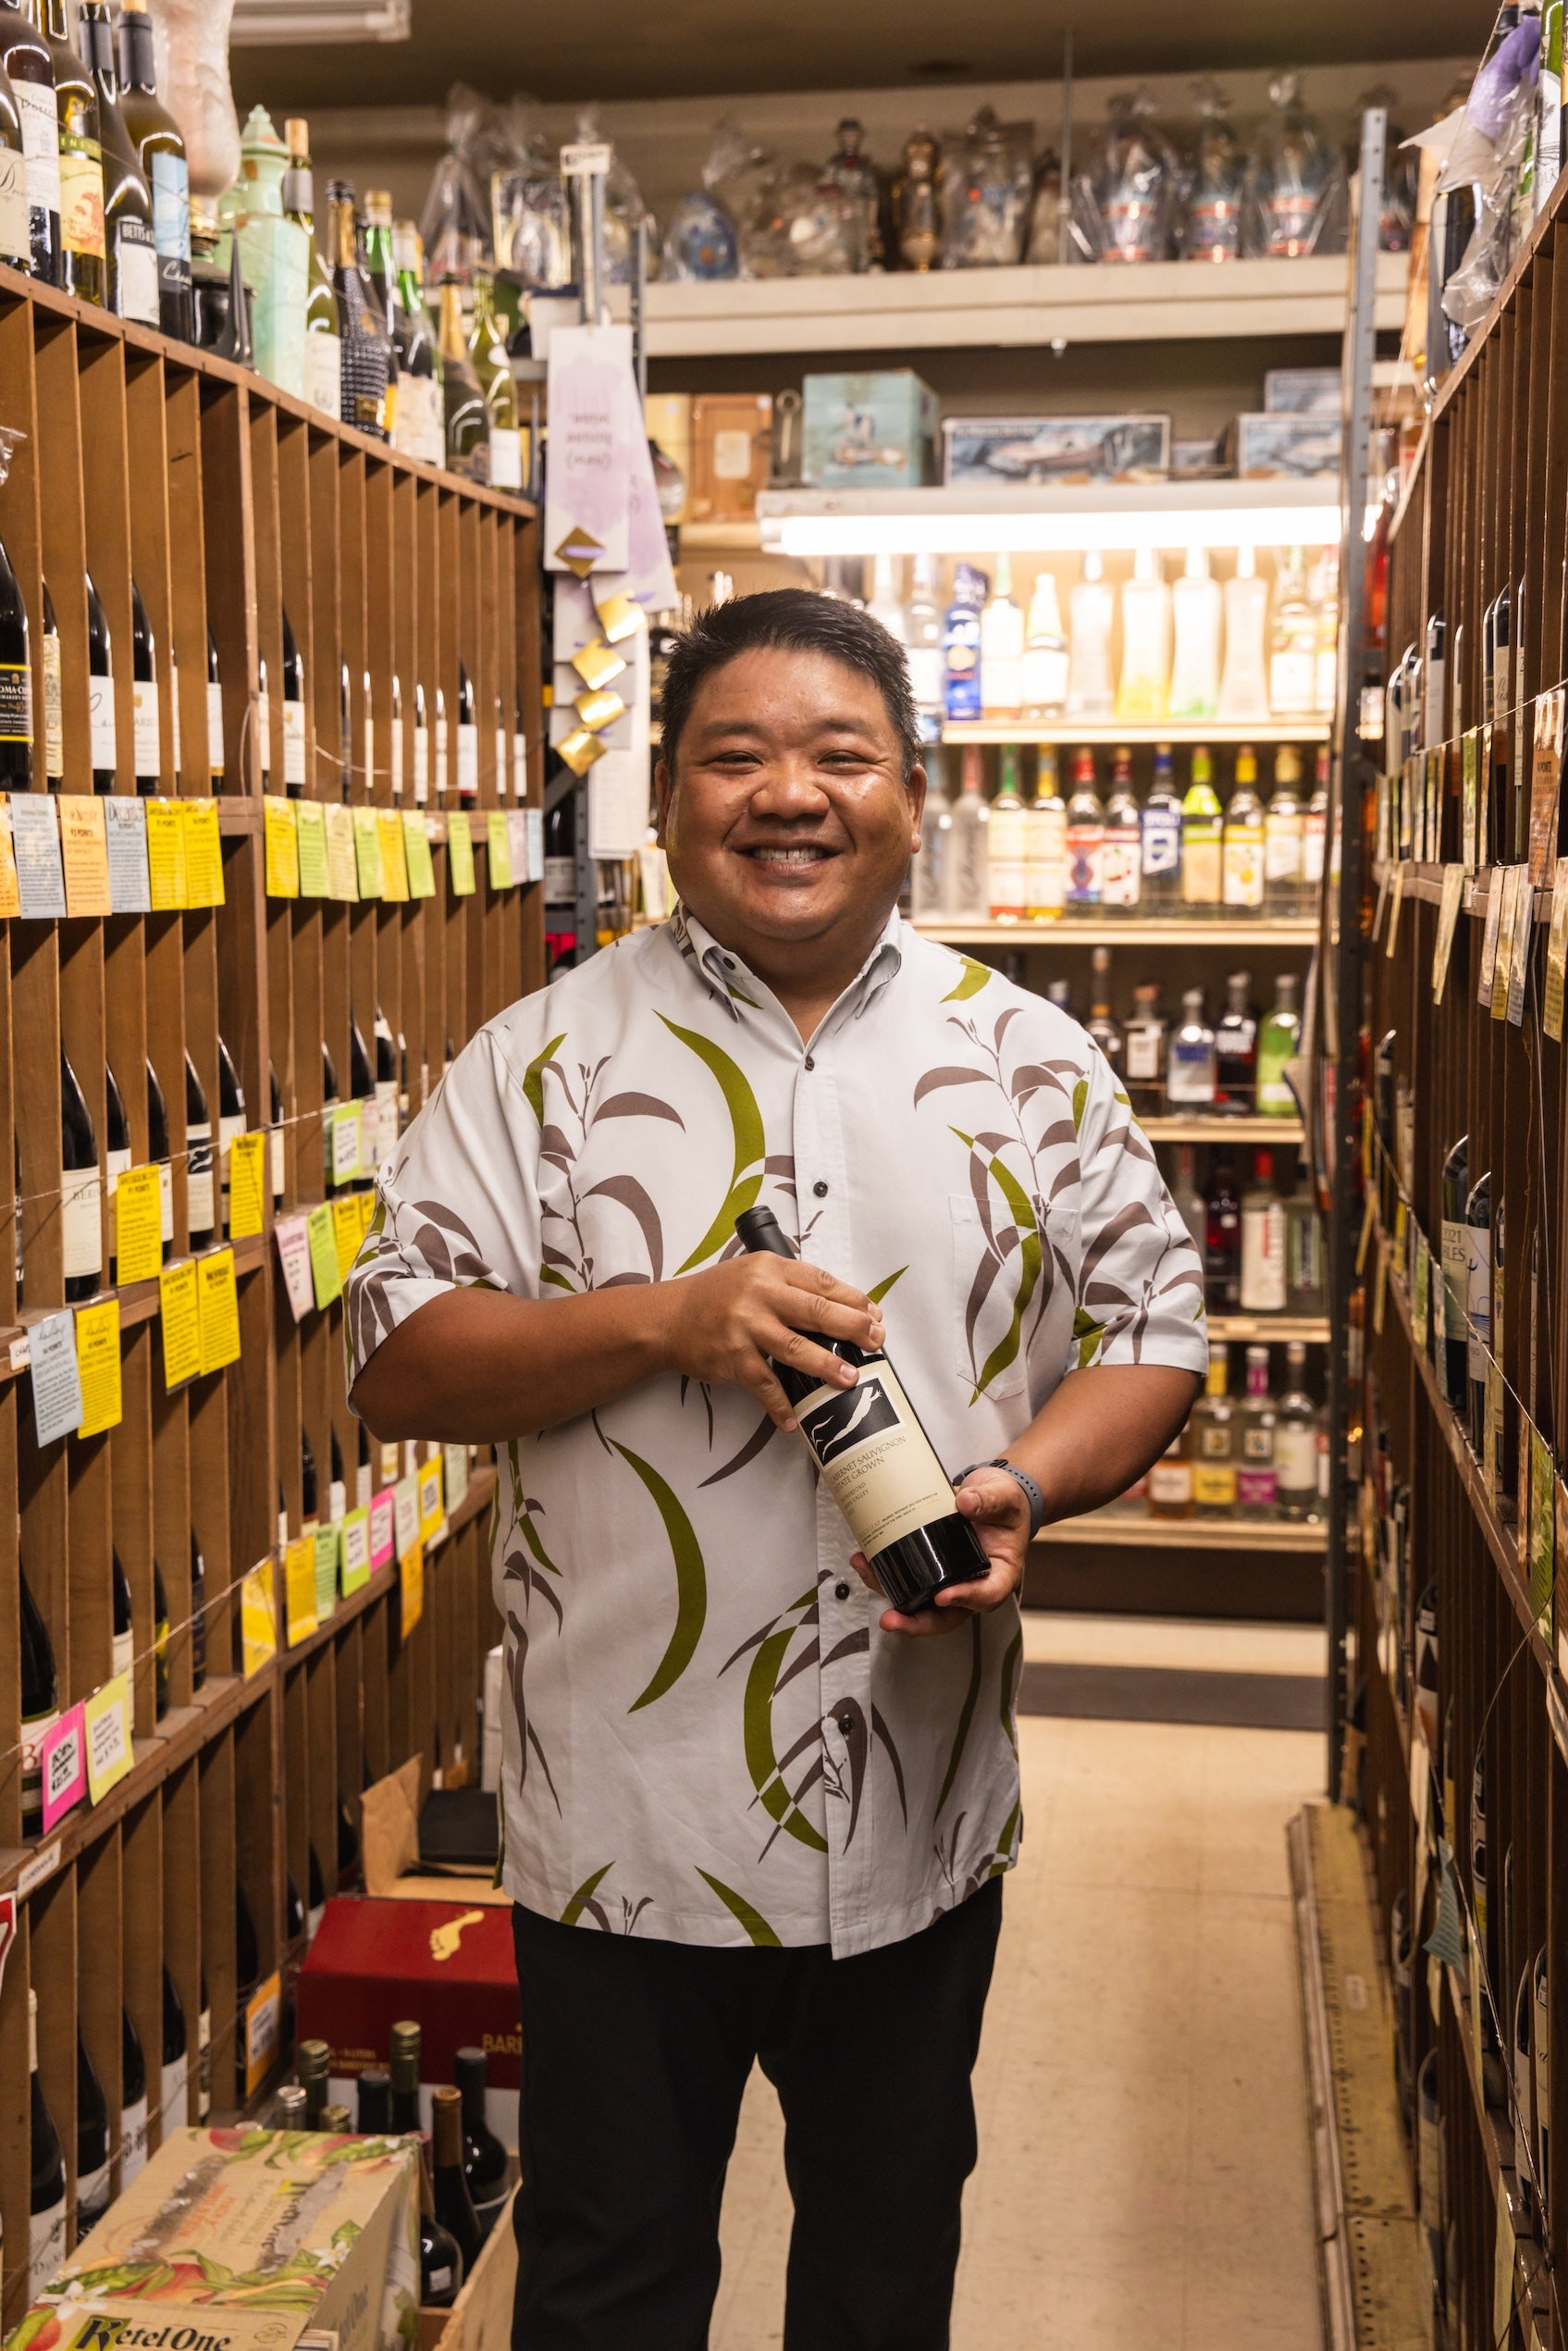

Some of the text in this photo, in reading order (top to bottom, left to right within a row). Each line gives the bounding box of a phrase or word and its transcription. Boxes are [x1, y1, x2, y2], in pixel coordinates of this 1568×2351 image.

[831, 1435, 907, 1482] CABERNET SAUVIGNON
[833, 1455, 885, 1493] ESTATE GROWN
[851, 1490, 869, 1505] VALLEY
[74, 2317, 231, 2351] Ketel One
